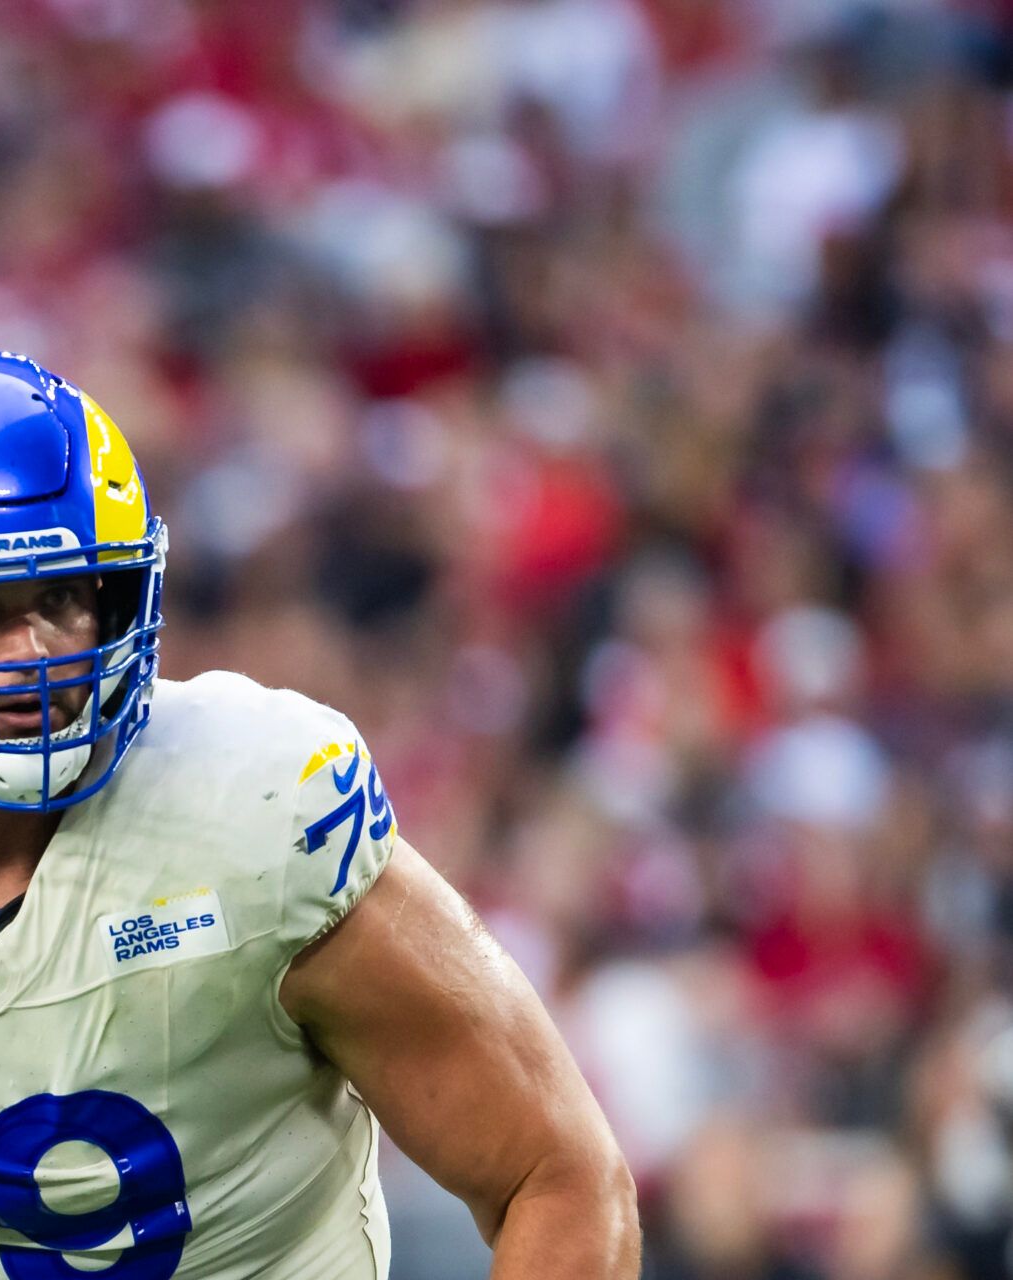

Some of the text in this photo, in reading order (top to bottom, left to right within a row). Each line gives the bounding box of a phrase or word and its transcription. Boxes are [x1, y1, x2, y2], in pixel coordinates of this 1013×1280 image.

[304, 761, 393, 897] 79
[109, 914, 154, 936] LOS
[113, 913, 215, 950] ANGELES
[116, 936, 180, 962] RAMS
